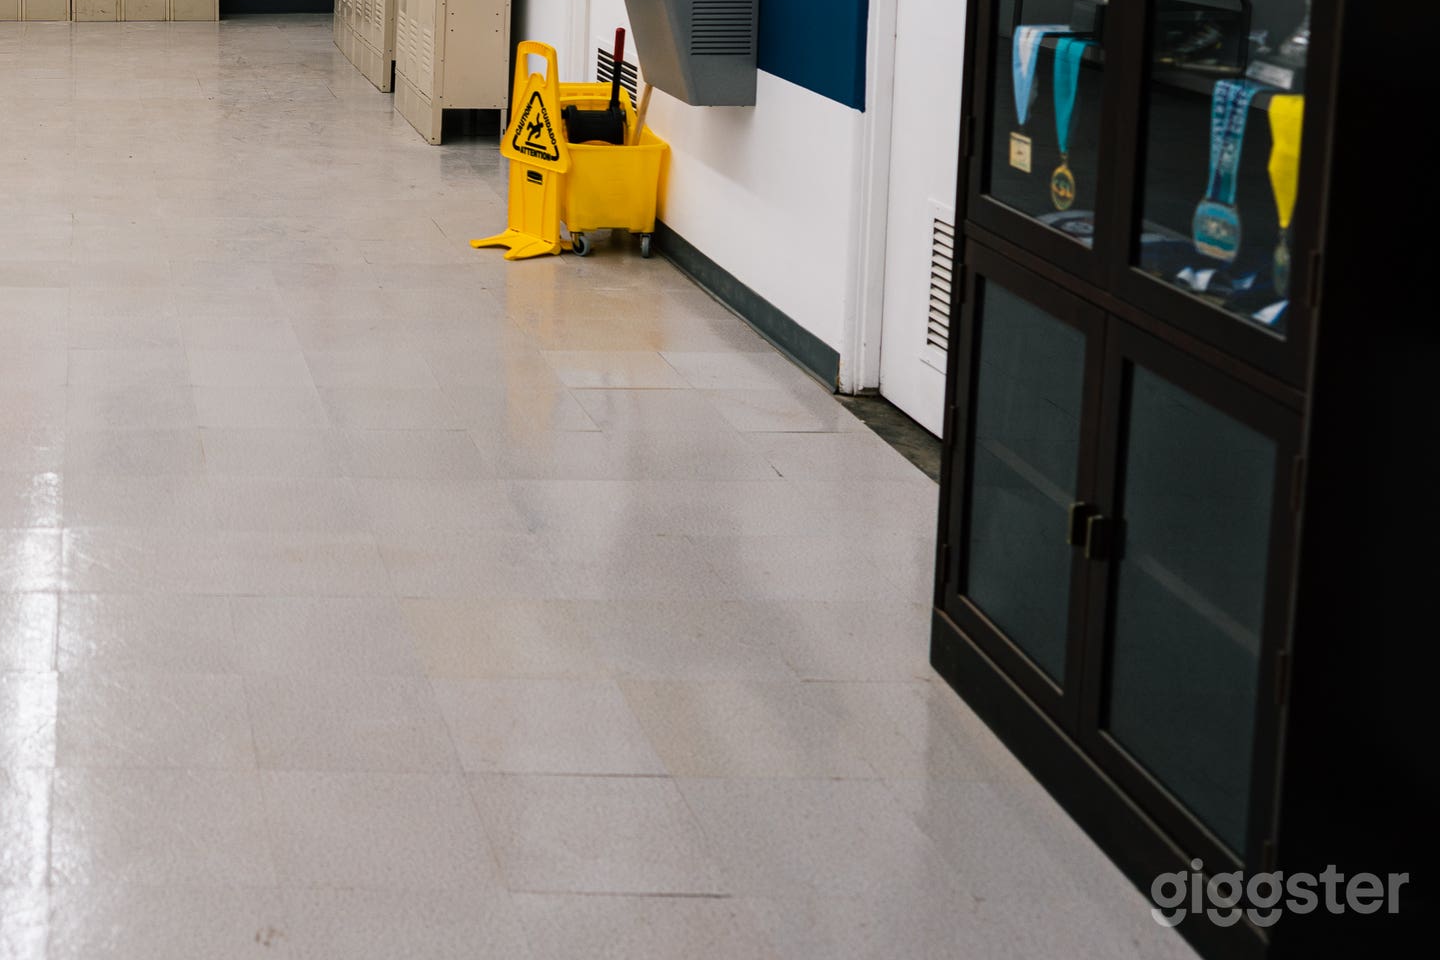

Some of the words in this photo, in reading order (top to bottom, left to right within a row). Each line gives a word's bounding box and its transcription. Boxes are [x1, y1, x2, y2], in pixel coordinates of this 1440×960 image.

[515, 103, 532, 136] CAUTION
[541, 106, 557, 145] CUIDADO
[519, 145, 551, 161] ATTENTION
